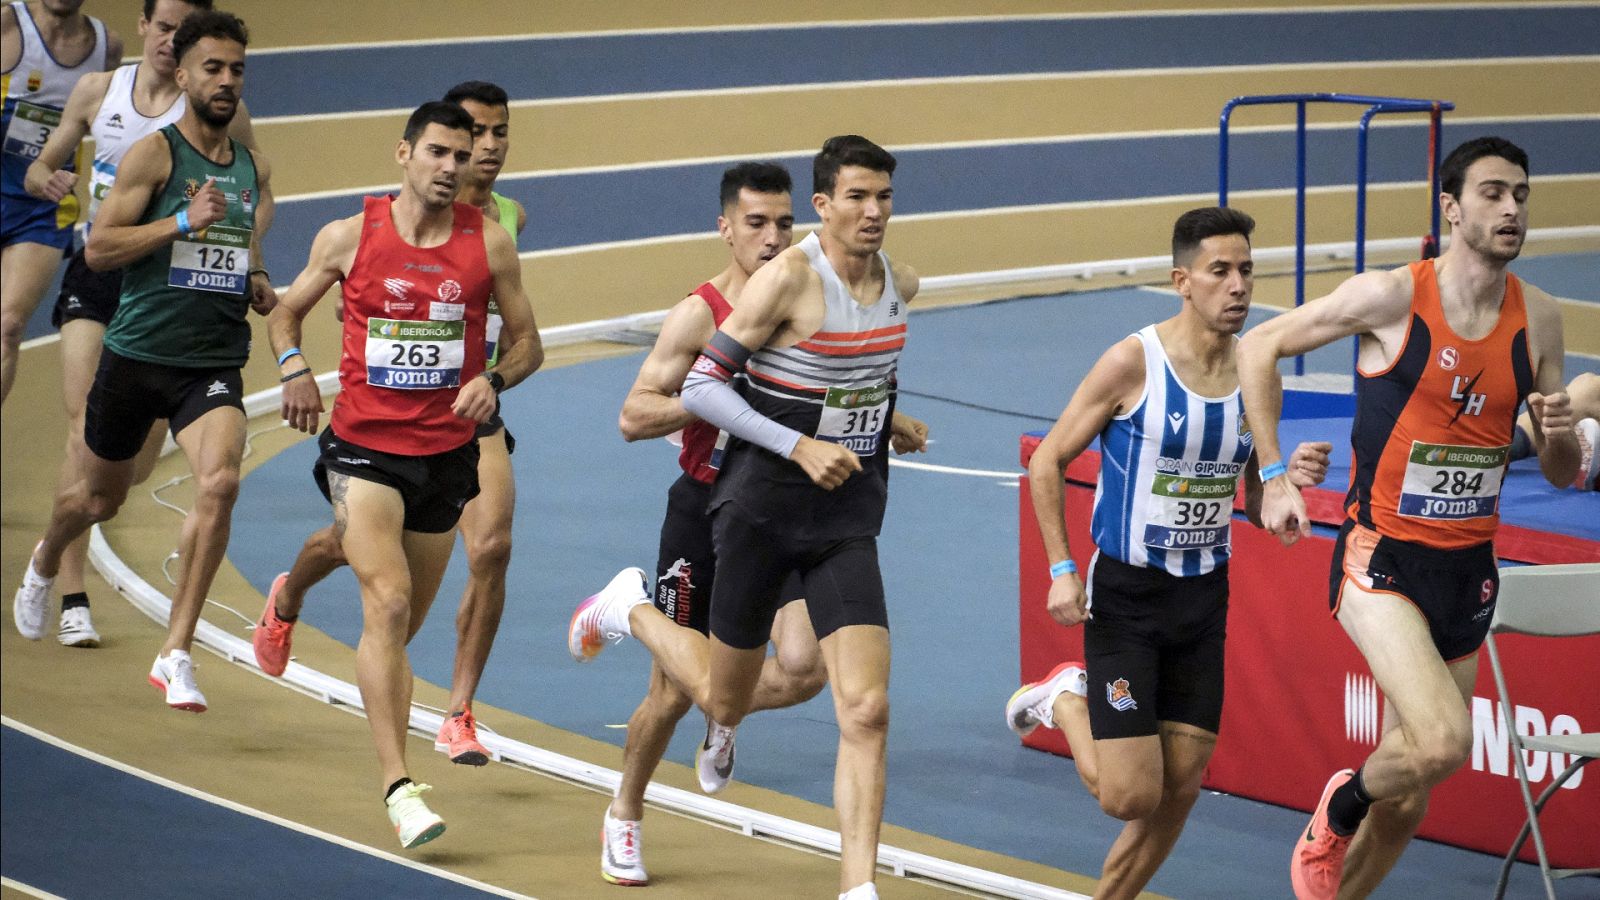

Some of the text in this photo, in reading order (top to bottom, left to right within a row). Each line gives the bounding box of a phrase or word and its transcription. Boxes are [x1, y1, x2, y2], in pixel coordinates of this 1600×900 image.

[198, 247, 235, 271] 126
[400, 326, 453, 337] IBERDROLA
[391, 344, 440, 367] 263
[843, 409, 880, 434] 315
[1155, 457, 1195, 472] ORAIN
[1447, 452, 1499, 464] IBERDROLA
[1188, 484, 1232, 493] IBERDROLA
[1431, 470, 1484, 496] 284
[1174, 501, 1221, 526] 392
